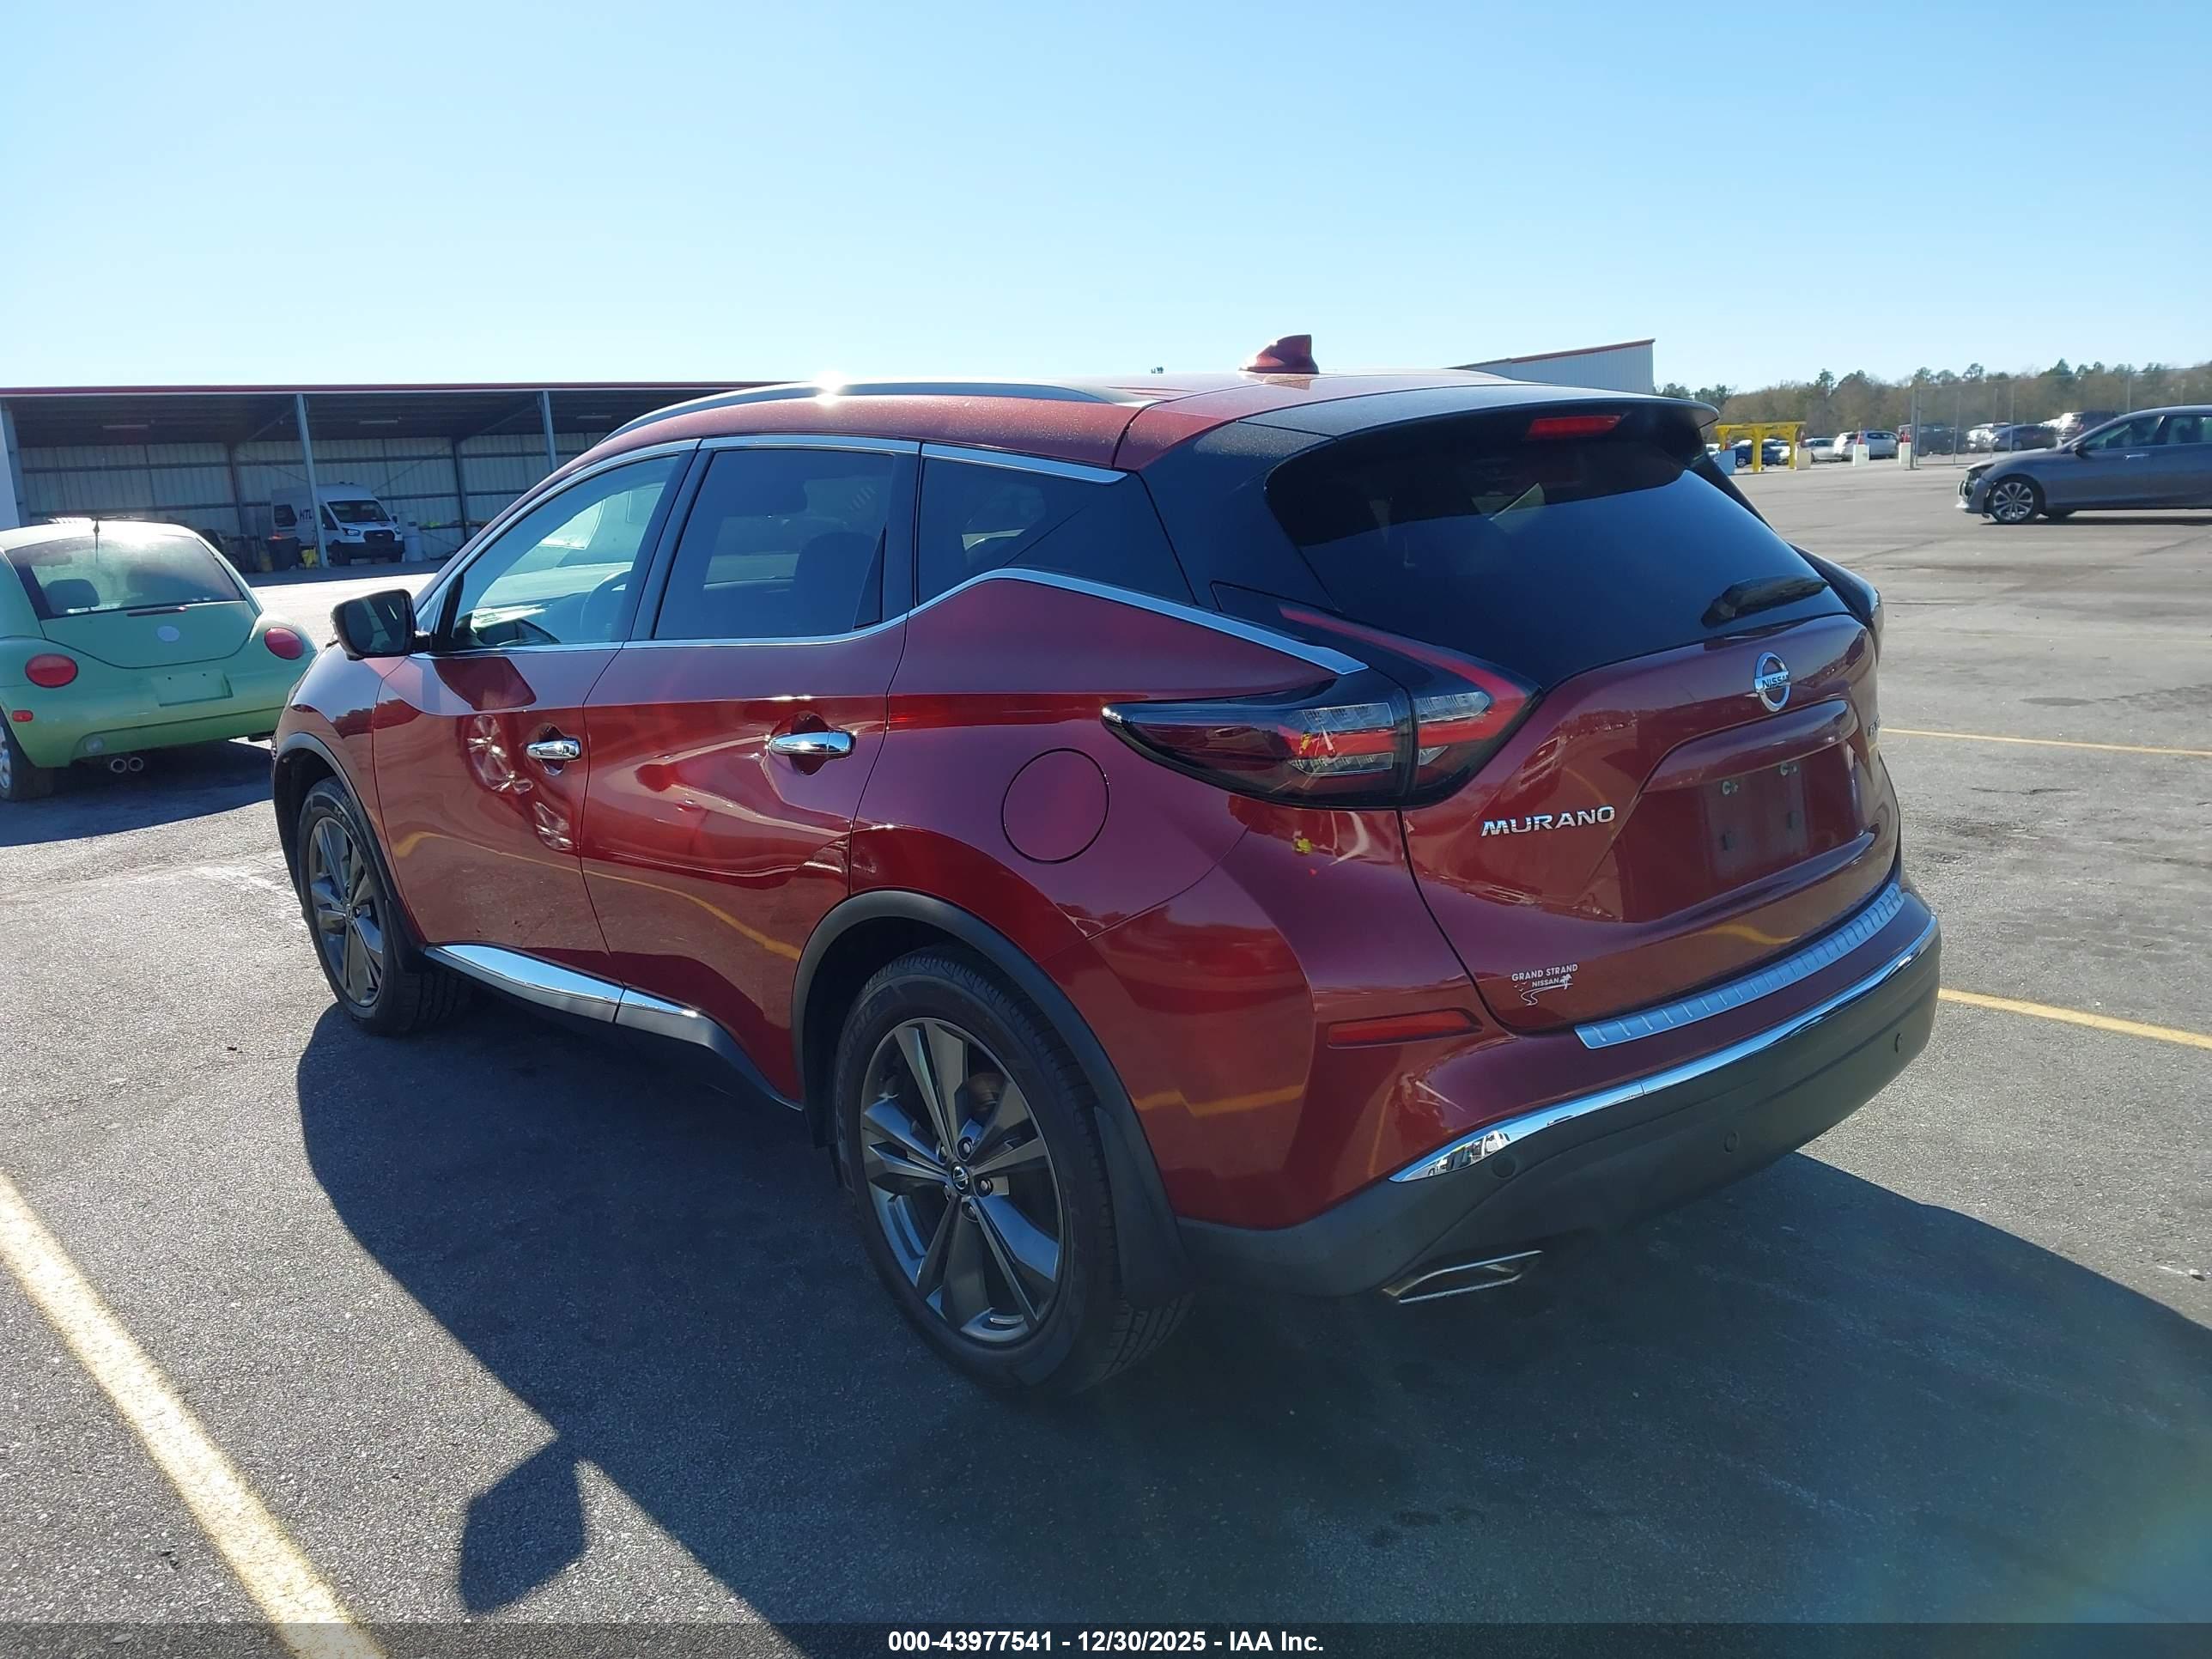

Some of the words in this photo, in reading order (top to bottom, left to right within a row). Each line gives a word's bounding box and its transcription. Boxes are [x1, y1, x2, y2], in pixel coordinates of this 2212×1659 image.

[1481, 805, 1615, 837] MURANO
[1511, 969, 1544, 981] GRAND
[1546, 963, 1578, 976] STRAND
[1532, 977, 1559, 988] NISSAN
